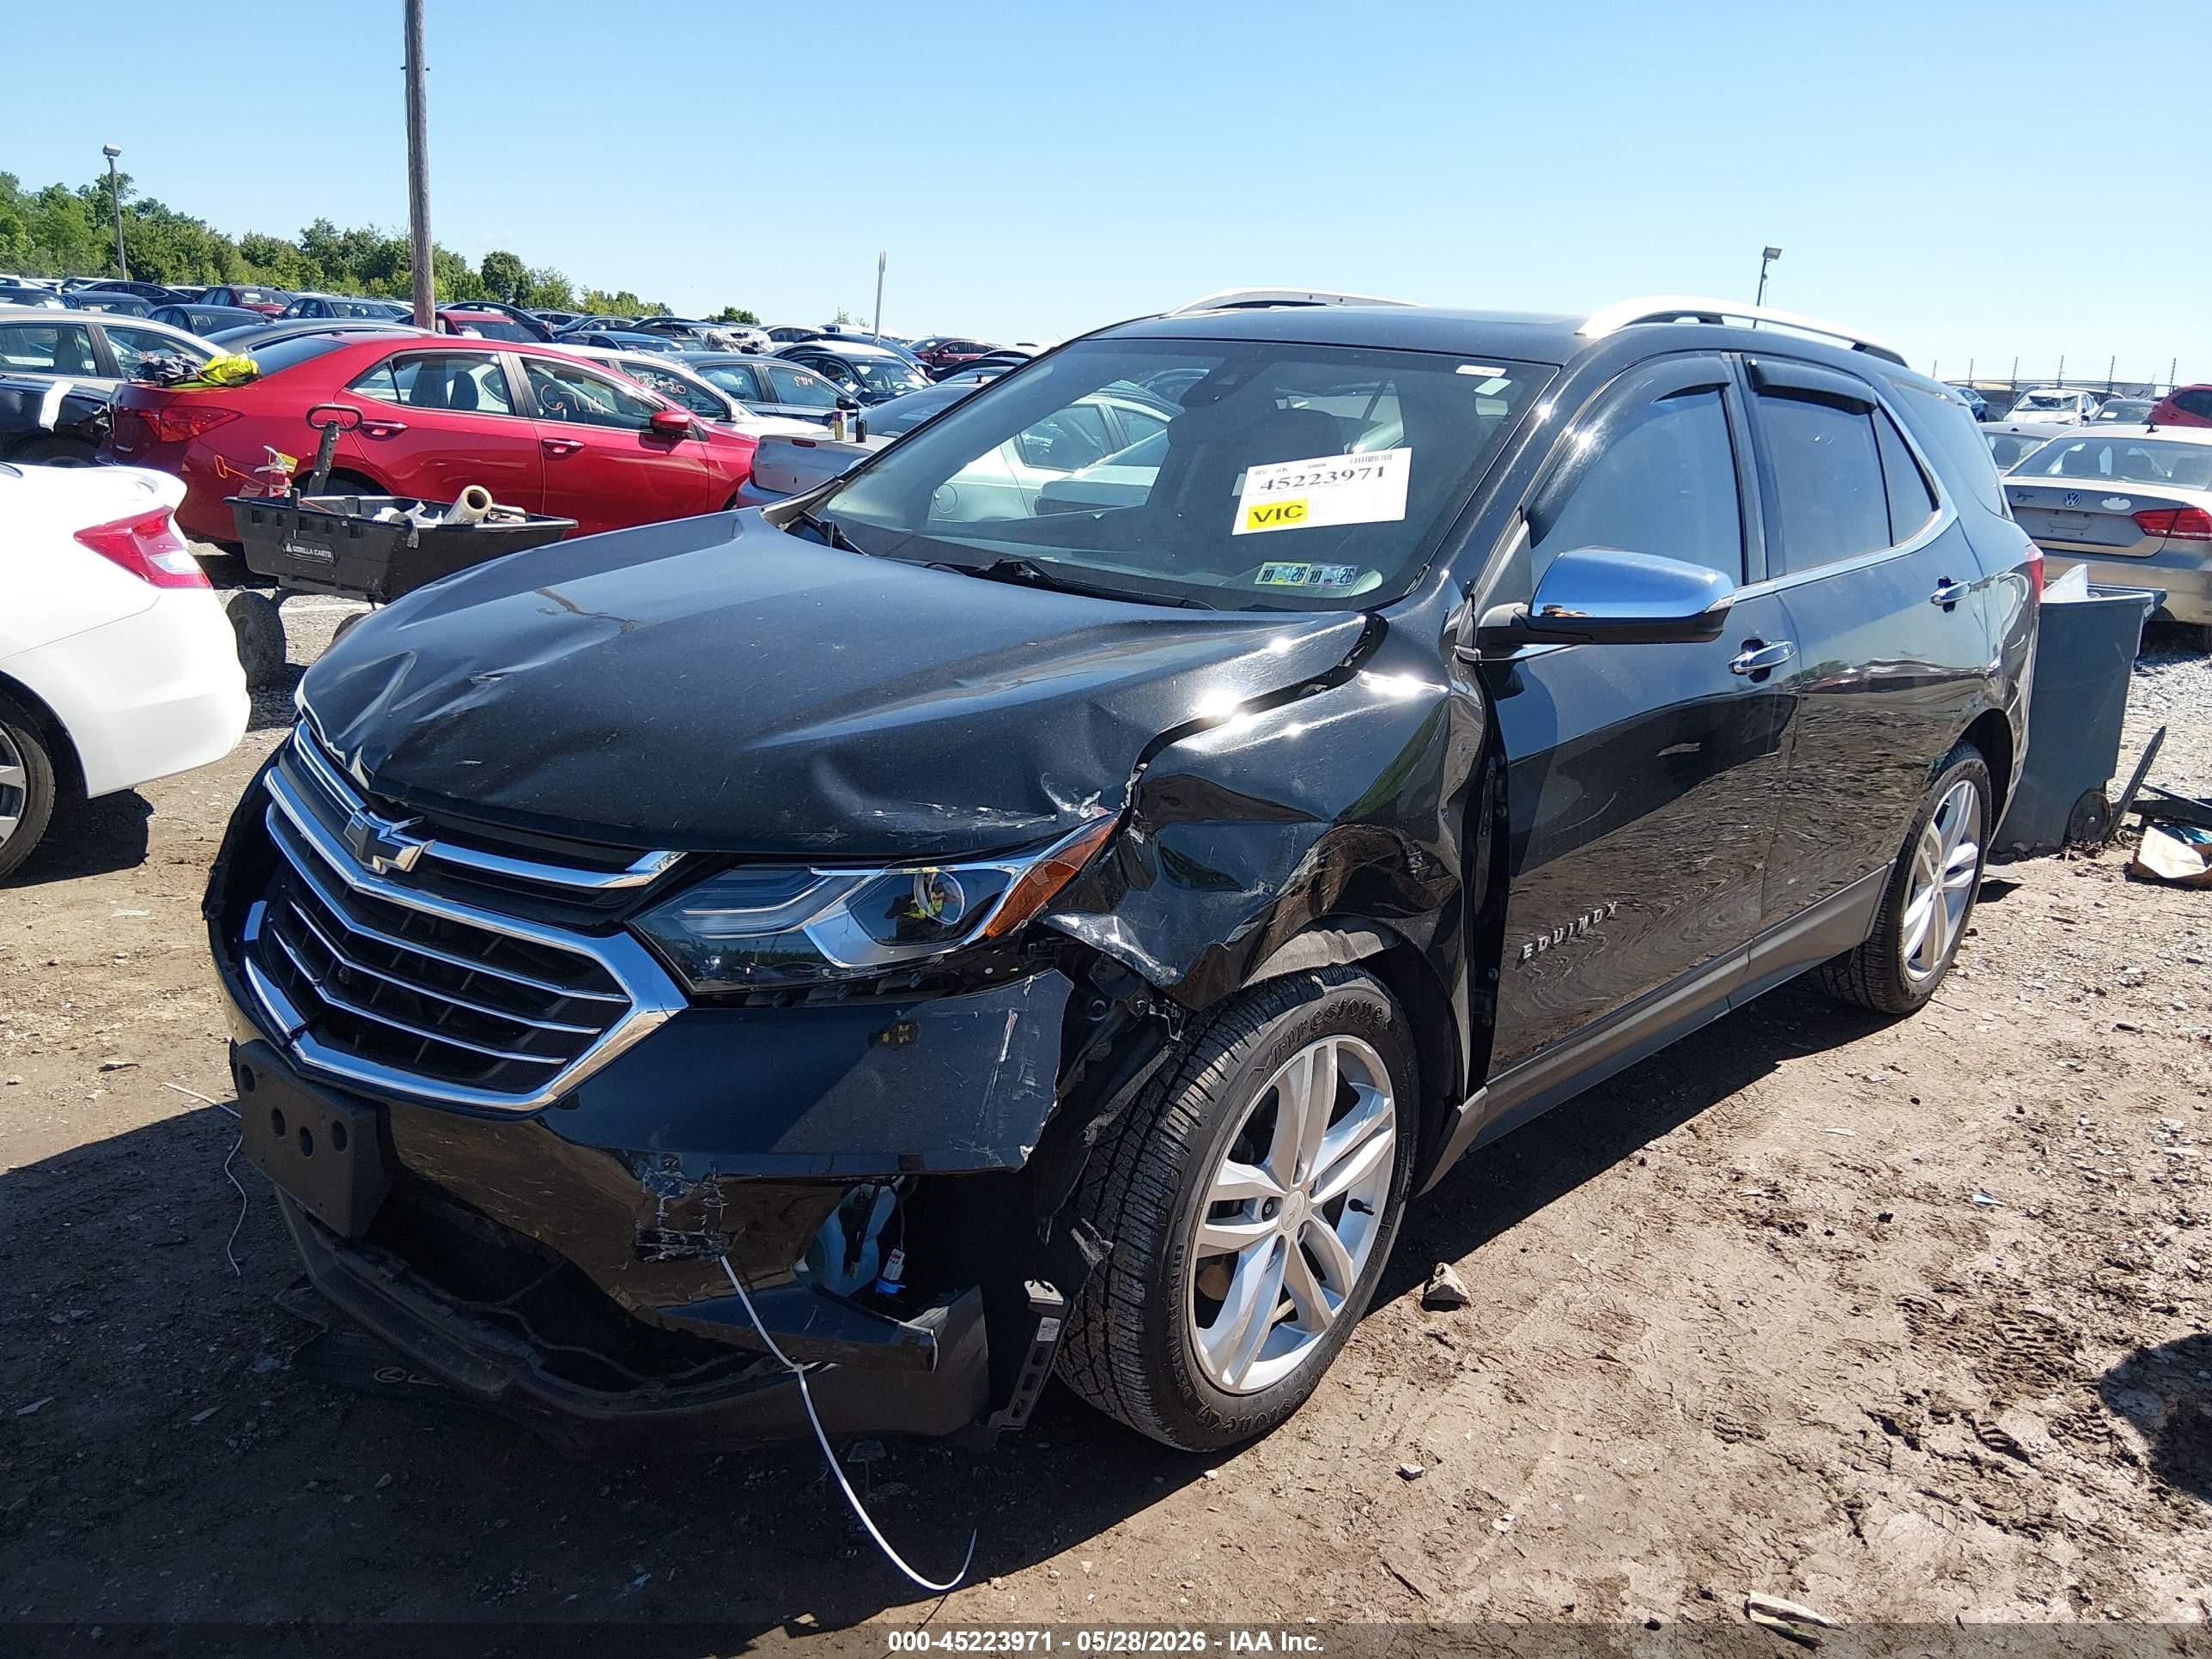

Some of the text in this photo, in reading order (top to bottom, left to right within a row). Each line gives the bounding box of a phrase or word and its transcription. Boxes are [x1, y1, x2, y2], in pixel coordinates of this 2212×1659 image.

[1260, 465, 1385, 491] 45223971
[1253, 505, 1304, 523] VIC
[1261, 567, 1306, 582] 10 26
[1309, 568, 1355, 584] 10 26
[1522, 902, 1618, 960] EQUINOX
